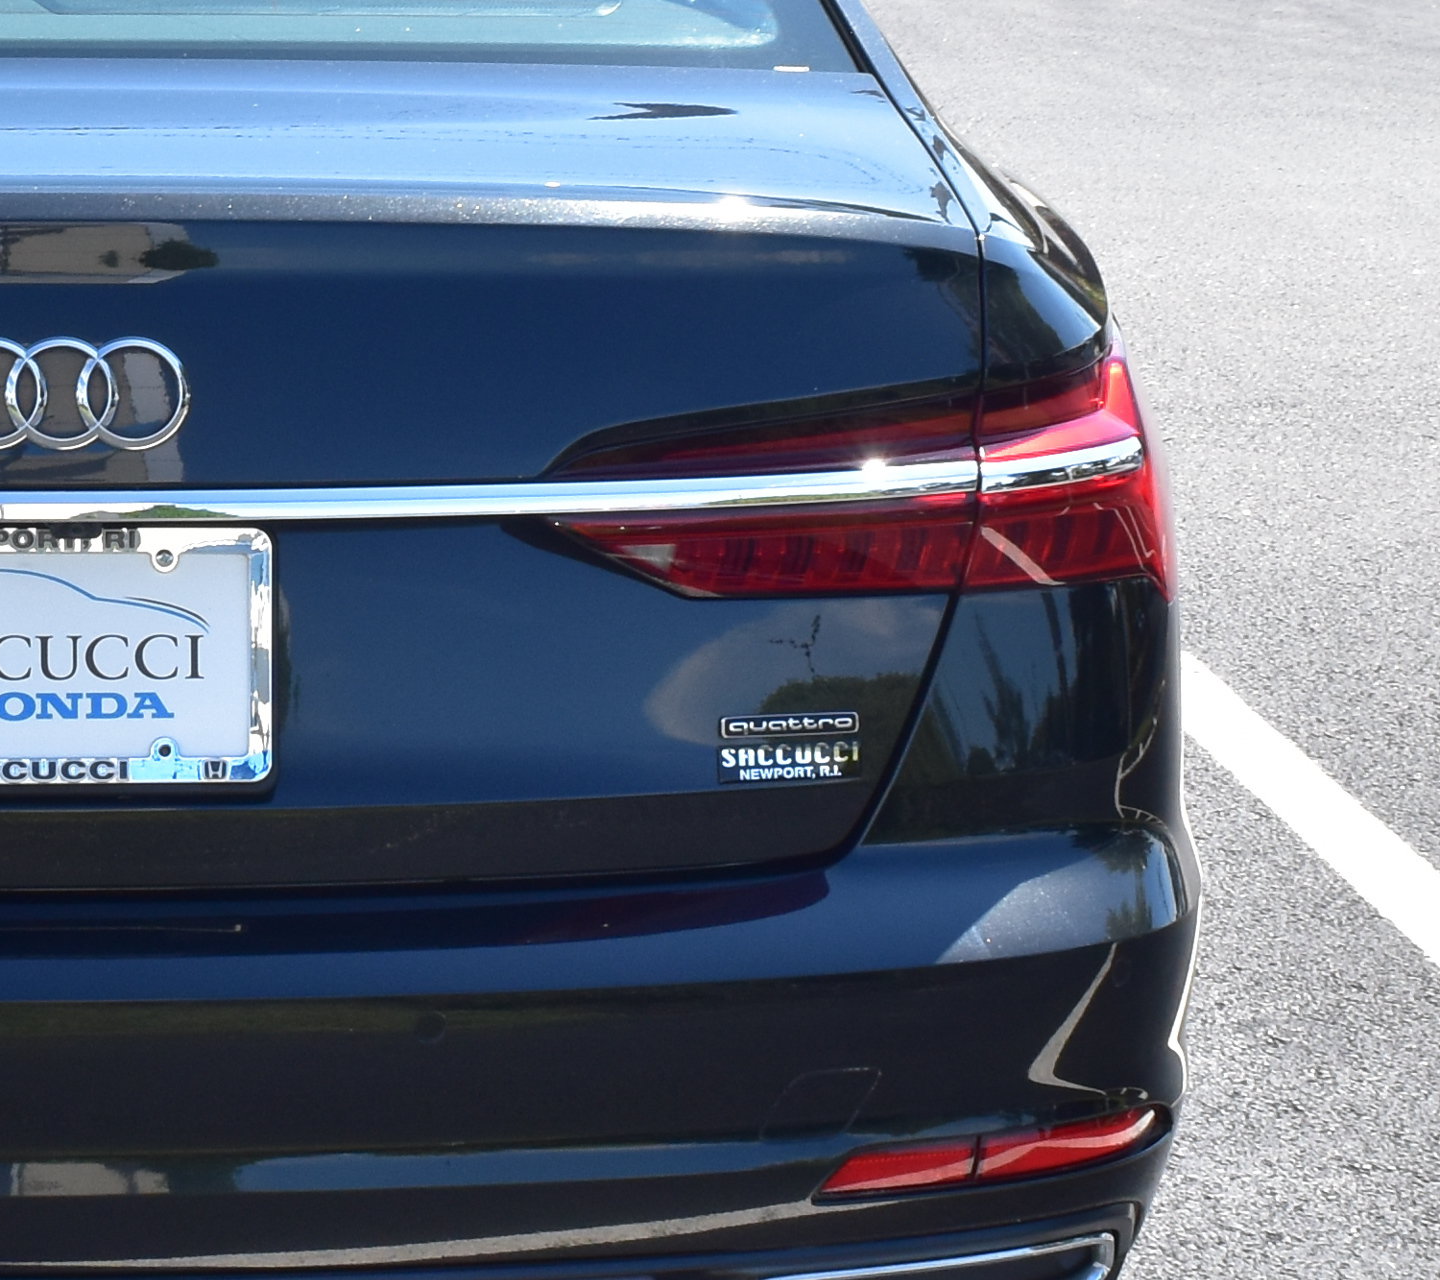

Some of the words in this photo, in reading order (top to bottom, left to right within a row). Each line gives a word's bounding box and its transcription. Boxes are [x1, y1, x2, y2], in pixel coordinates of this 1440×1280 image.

[102, 528, 141, 552] RI
[729, 717, 852, 735] quattro
[740, 766, 816, 780] NEWPORT,
